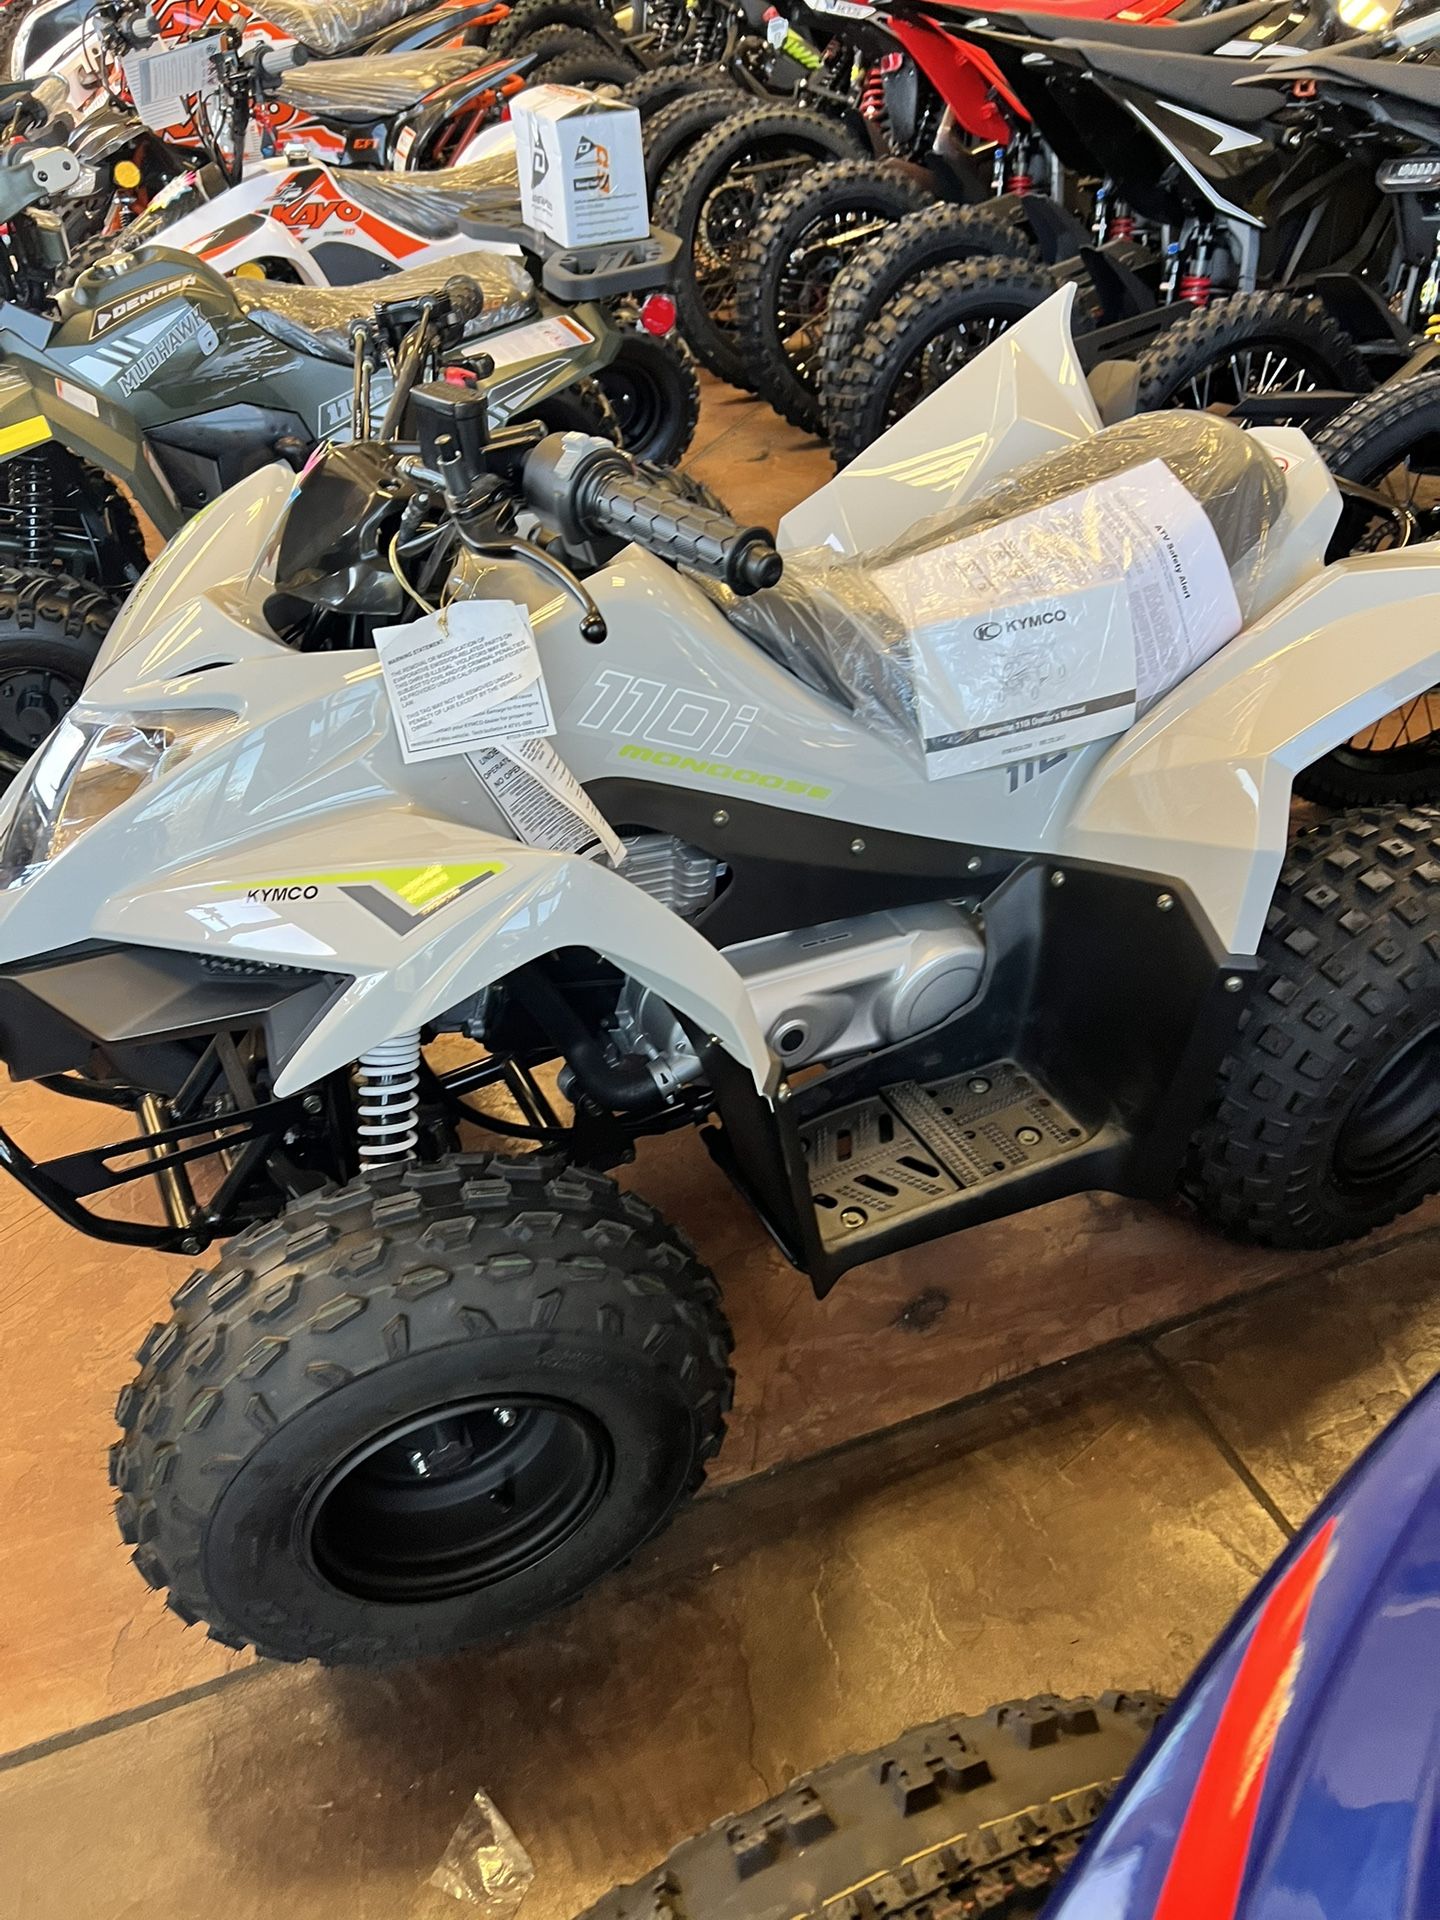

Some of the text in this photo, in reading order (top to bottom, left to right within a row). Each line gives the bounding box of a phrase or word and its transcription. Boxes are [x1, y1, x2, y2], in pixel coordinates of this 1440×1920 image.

[270, 187, 363, 230] KAYO
[116, 302, 220, 398] MUDHAWK 6
[1154, 524, 1191, 599] ATV Safety Alert
[1004, 609, 1067, 633] KYMCO
[577, 670, 760, 758] 110i
[617, 743, 833, 801] MONGOOSE
[246, 885, 319, 905] KYMCO
